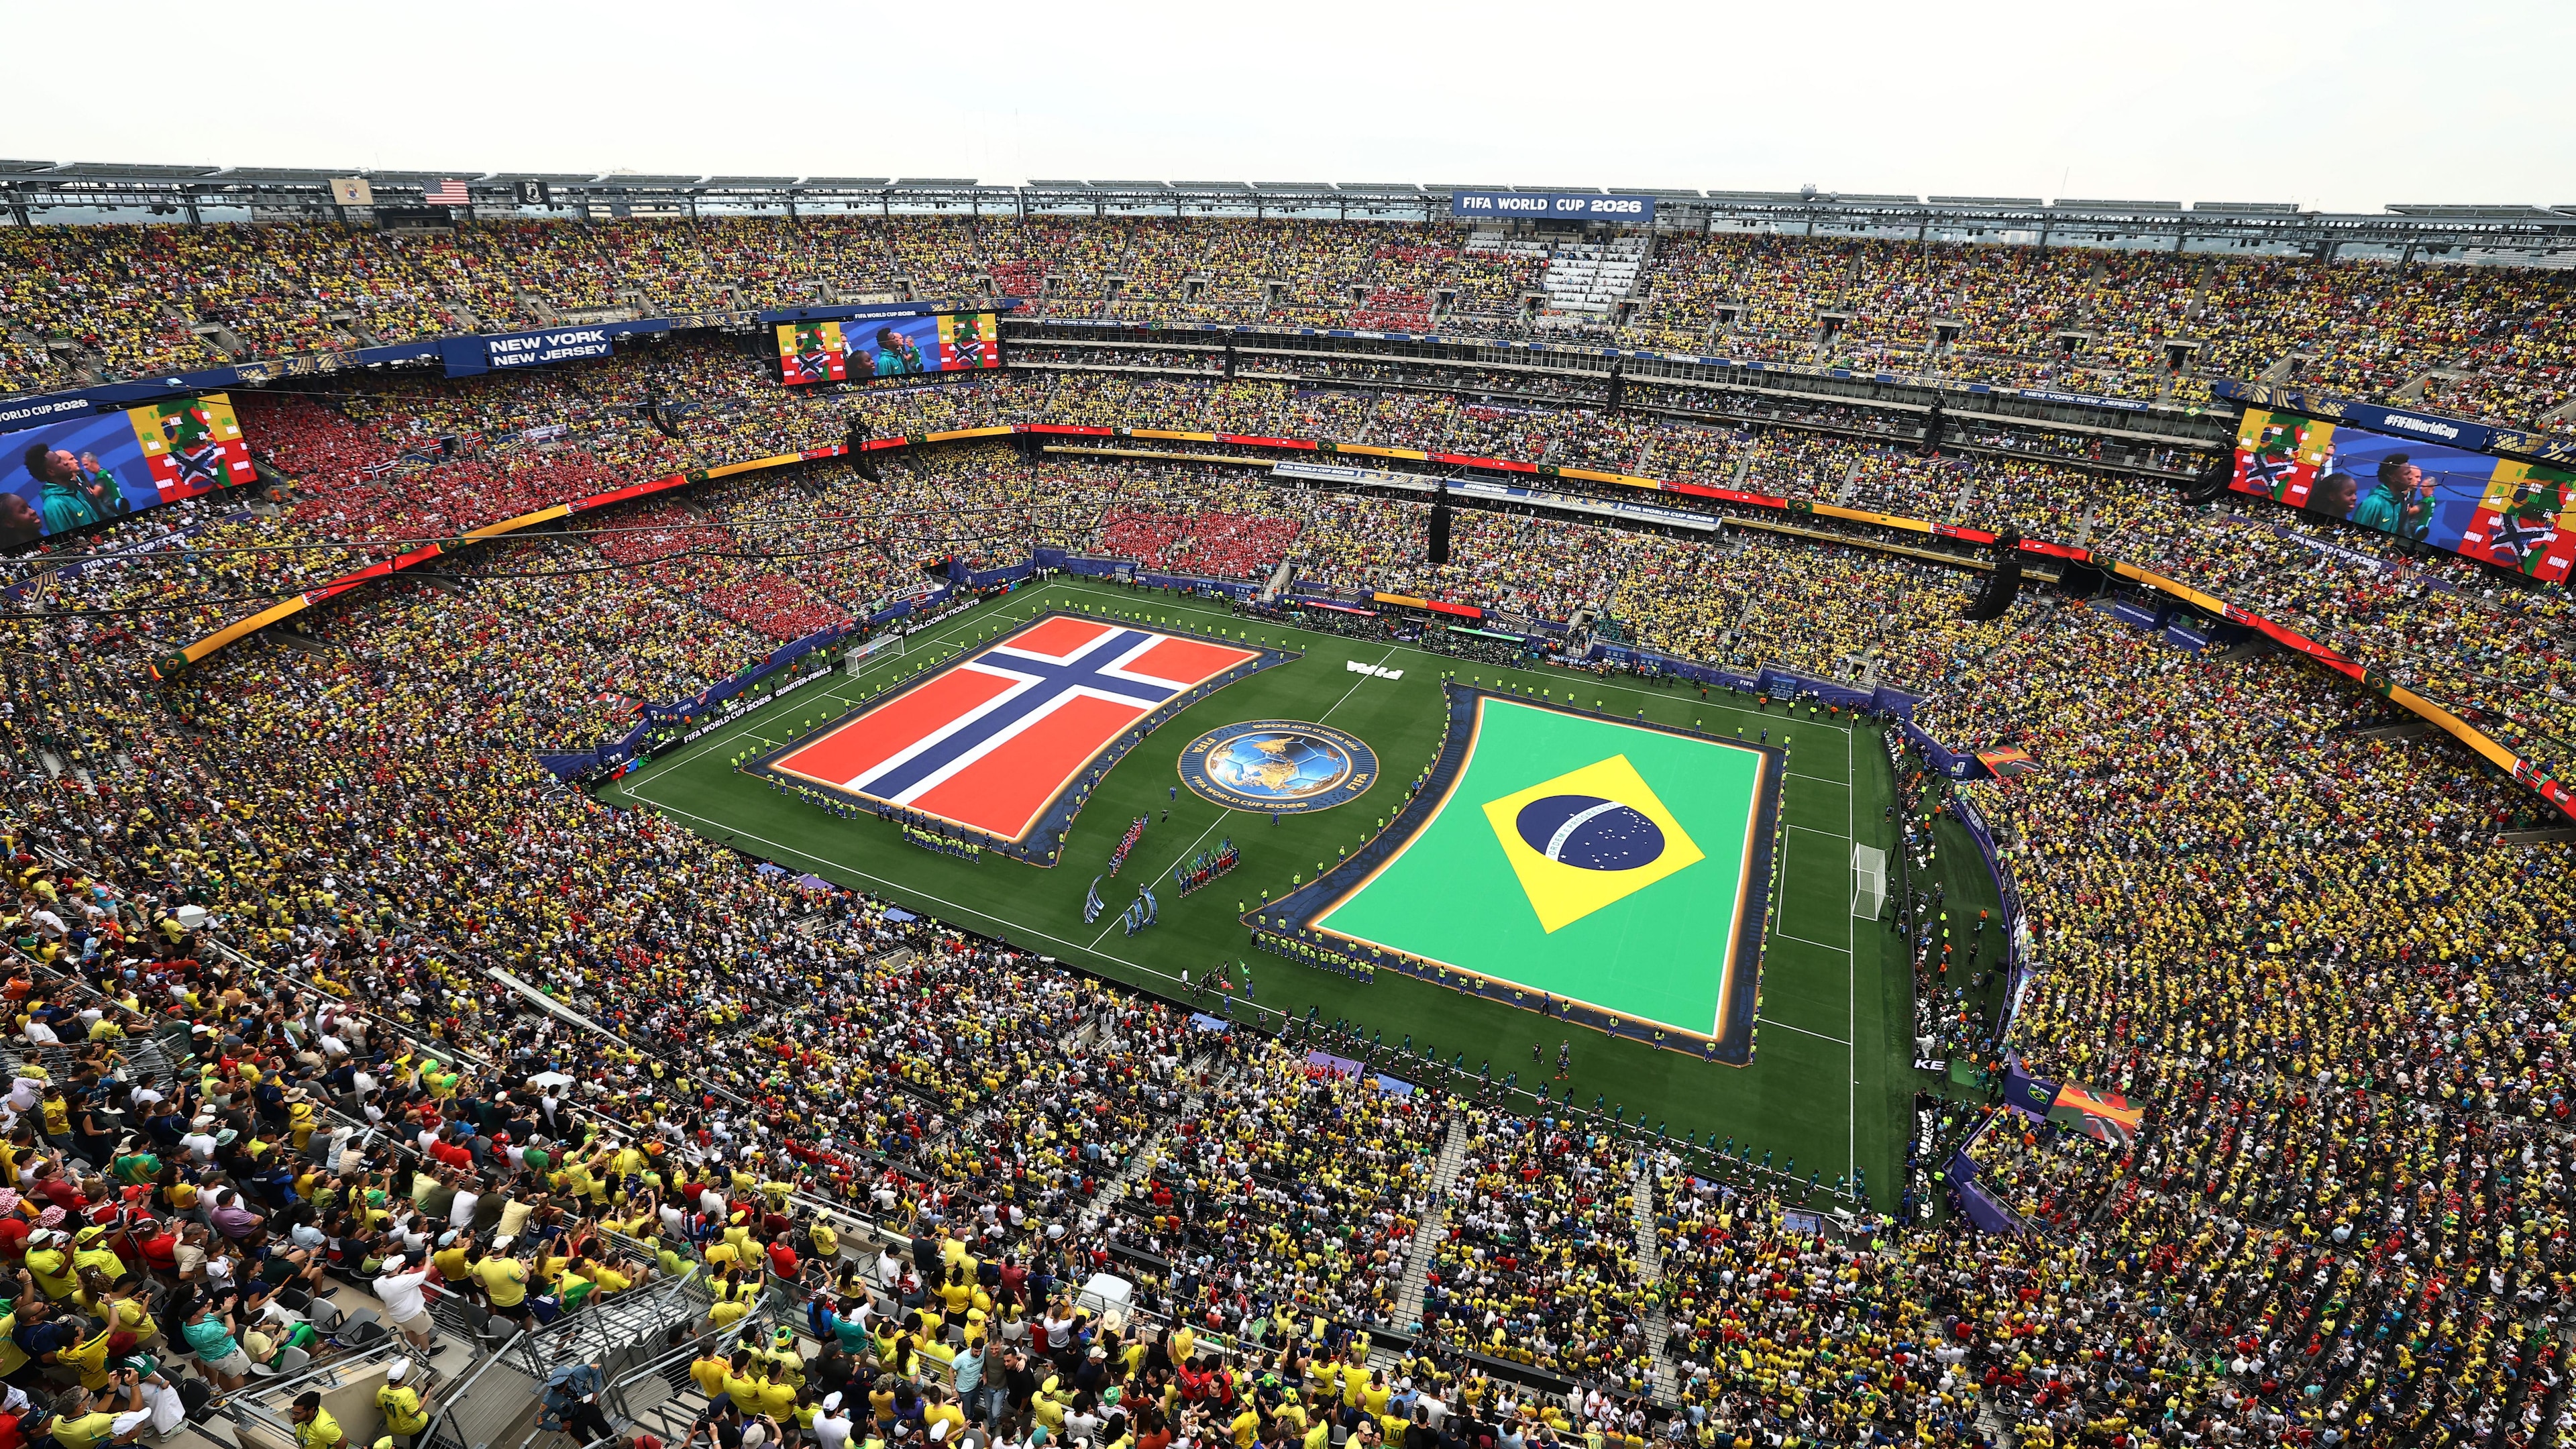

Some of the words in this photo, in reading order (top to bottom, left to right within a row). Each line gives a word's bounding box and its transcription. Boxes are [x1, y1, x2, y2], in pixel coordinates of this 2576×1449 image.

[1462, 197, 1493, 209] FIFA
[1497, 197, 1548, 211] WORLD
[1556, 199, 1587, 211] CUP
[1591, 200, 1644, 213] 2026
[490, 337, 541, 354] NEW
[545, 329, 606, 347] YORK
[493, 352, 536, 366] NEW
[539, 344, 606, 361] JERSEY
[32, 405, 52, 416] CUP
[53, 399, 89, 412] 2026
[2024, 390, 2047, 399] NEW
[2048, 394, 2076, 402] YORK
[2076, 396, 2100, 405] NEW
[2101, 400, 2143, 409] JERSEY
[2383, 414, 2459, 440] #FIFAWorldCup
[1463, 483, 1508, 494] #FIFAWorldCup
[1642, 507, 1670, 516] WORLD
[1686, 514, 1715, 523] 2026
[2463, 530, 2483, 543] NORW
[2288, 533, 2304, 545] FIFA
[2304, 539, 2334, 553] WORLD
[2334, 547, 2352, 559] CUP
[81, 559, 105, 572] FIFA
[137, 542, 155, 553] CUP
[2547, 555, 2569, 570] NORW
[906, 598, 979, 637] FIFA.COM/TICKETS
[1739, 679, 1754, 688] FIFA
[678, 704, 692, 713] FIFA
[684, 730, 702, 744] FIFA
[701, 715, 731, 735] WORLD
[730, 708, 746, 721] CUP
[745, 695, 773, 712] 2026
[775, 665, 833, 696] QUARTER-FINALS
[1191, 737, 1217, 754] FIFA
[1345, 773, 1370, 792] FIFA
[1191, 775, 1208, 789] FIFA
[1205, 787, 1240, 803] WORLD
[1240, 800, 1264, 808] CUP
[1548, 833, 1566, 856] ORDEM
[1567, 804, 1616, 829] PROGRESSO
[1914, 1059, 1946, 1071] KE
[769, 1192, 777, 1201] 10
[384, 1400, 397, 1418] 10
[1390, 1429, 1401, 1441] 10
